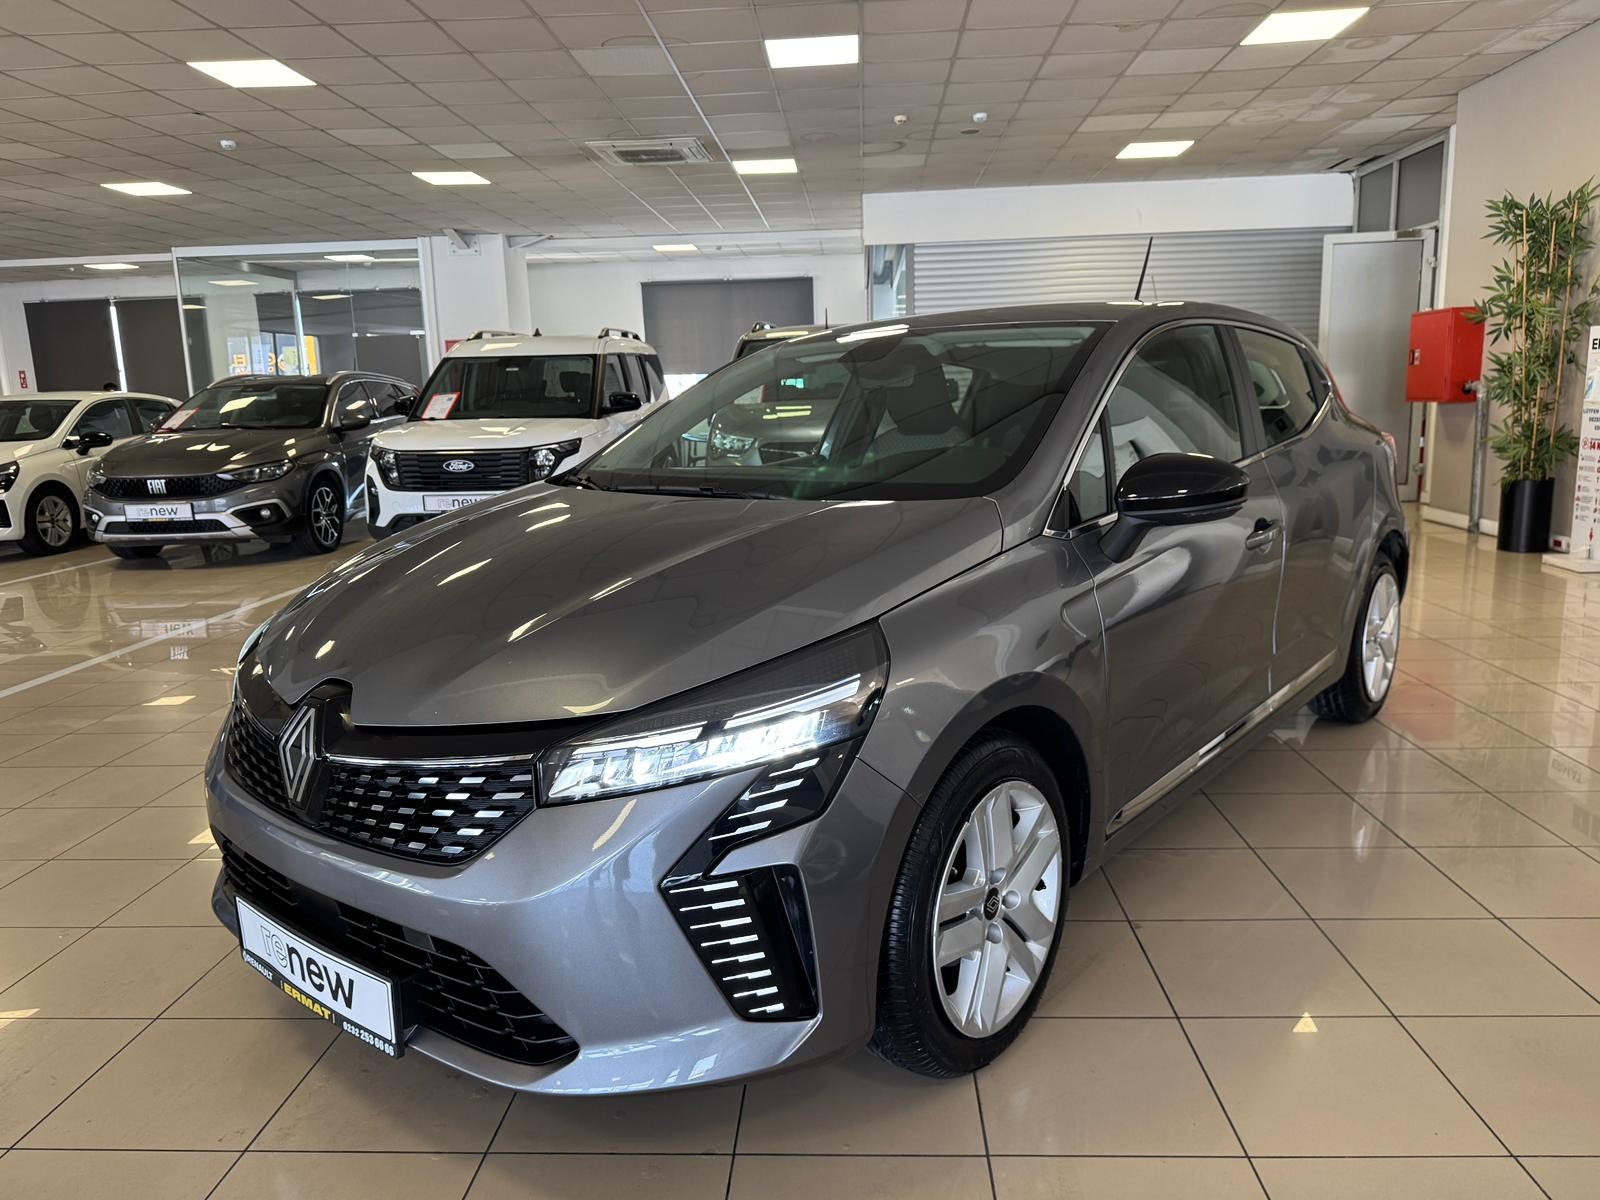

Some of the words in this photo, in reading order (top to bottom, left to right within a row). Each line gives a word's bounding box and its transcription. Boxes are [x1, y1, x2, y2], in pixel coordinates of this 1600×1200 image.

[146, 479, 167, 494] FIAT
[260, 924, 355, 1010] renew
[283, 982, 332, 1020] ERMAT
[342, 1021, 360, 1037] 0232
[360, 1029, 375, 1045] 253
